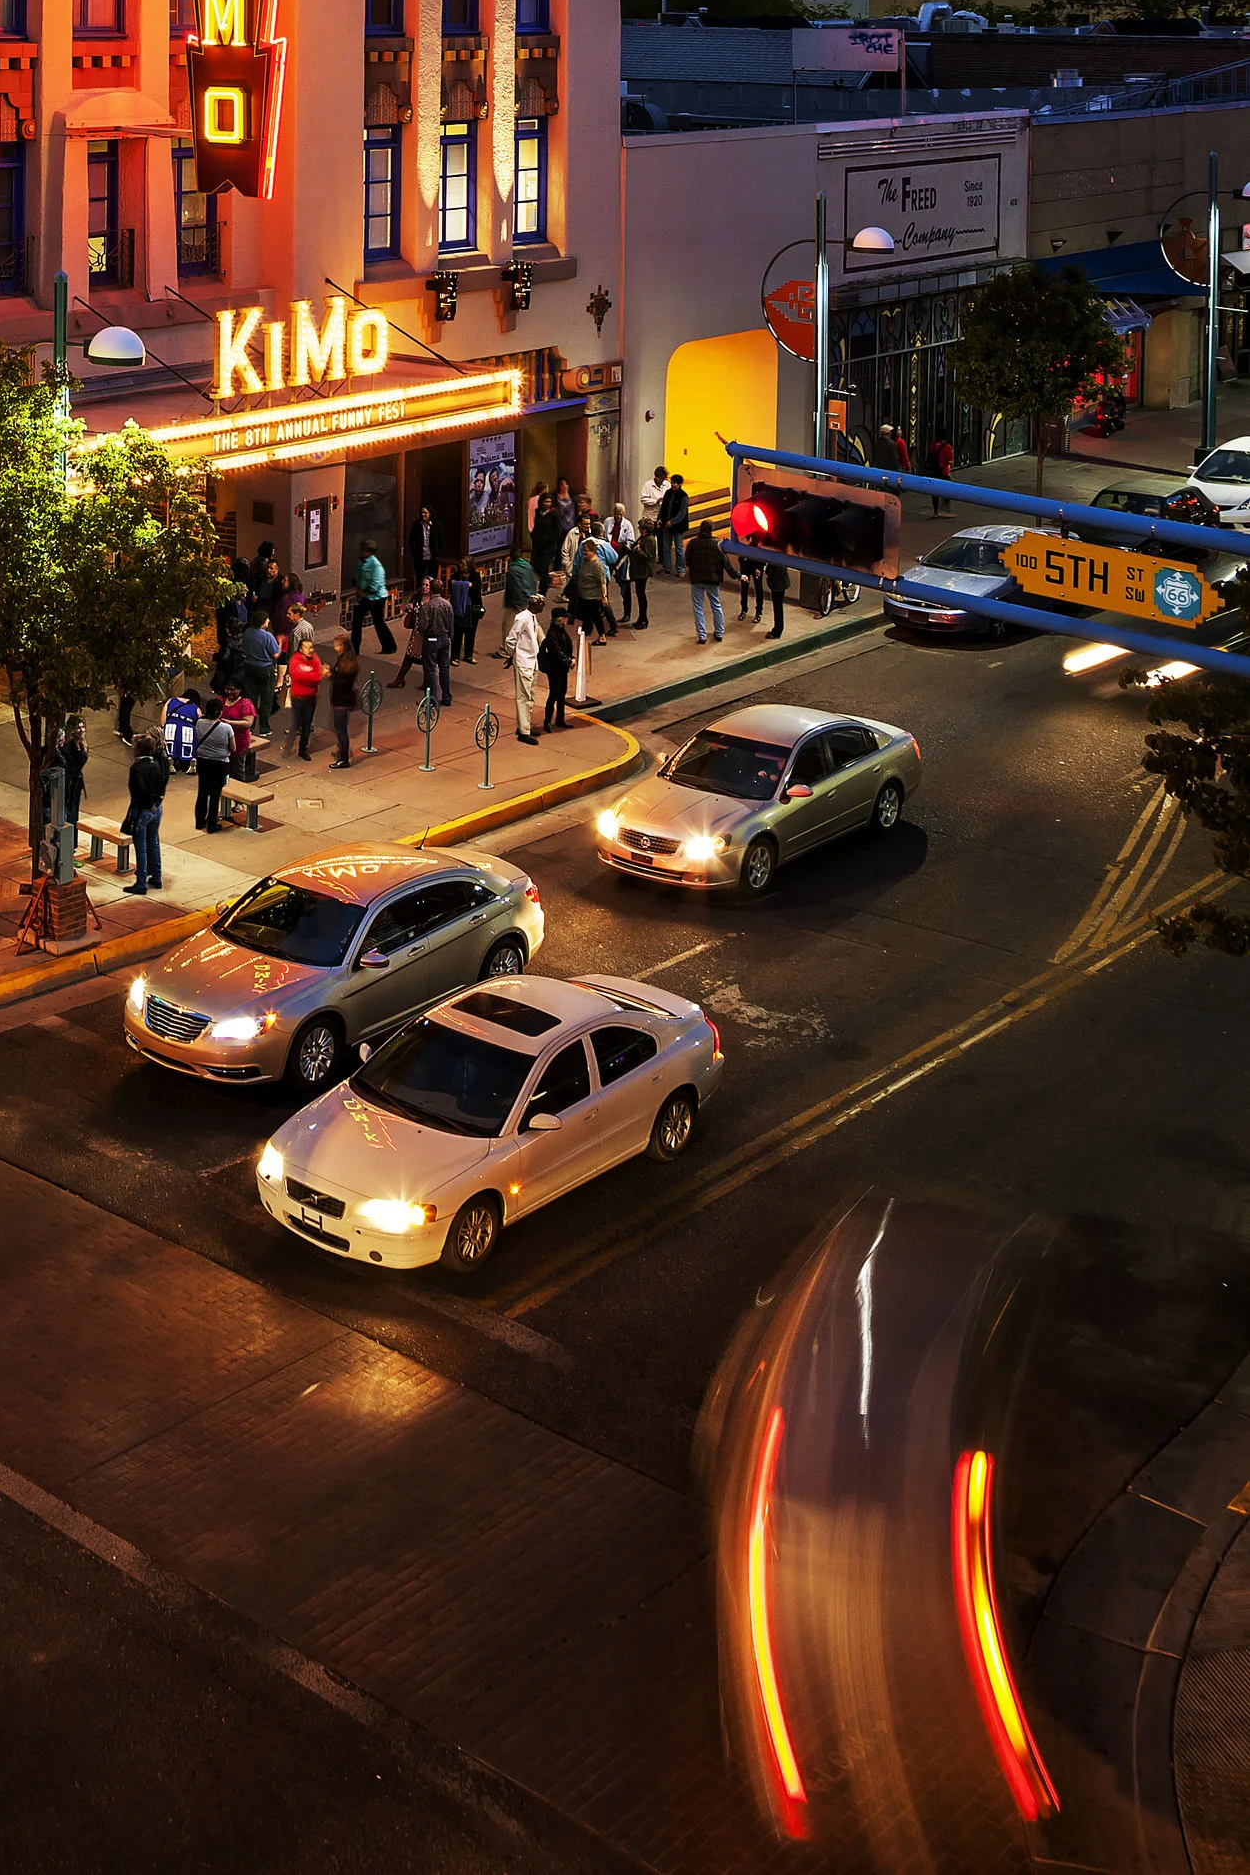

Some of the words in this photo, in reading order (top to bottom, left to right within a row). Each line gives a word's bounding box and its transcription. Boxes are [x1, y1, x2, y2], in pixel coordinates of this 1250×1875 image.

[878, 177, 898, 205] The
[901, 176, 937, 212] FREED
[964, 180, 983, 193] Since
[967, 195, 983, 207] 1920
[902, 221, 956, 251] Company
[214, 432, 239, 453] THE
[245, 426, 270, 447] 8TH
[276, 419, 328, 442] ANNUAL
[332, 408, 373, 432] FUNNY
[378, 401, 406, 421] FEST
[1015, 552, 1037, 570] 100
[1045, 549, 1109, 595] 5TH
[1126, 566, 1145, 582] ST
[1125, 586, 1145, 603] SW
[1167, 588, 1188, 603] 66
